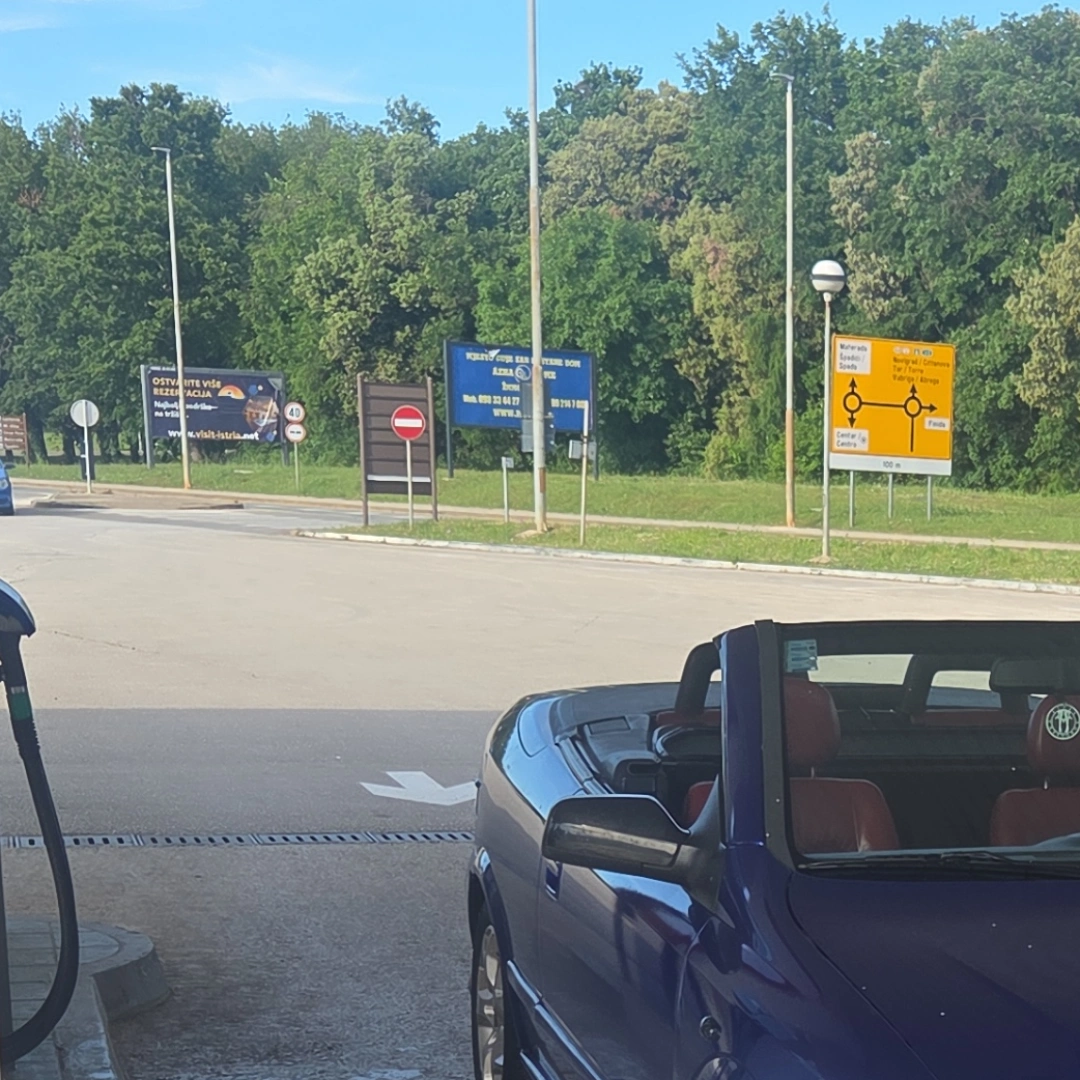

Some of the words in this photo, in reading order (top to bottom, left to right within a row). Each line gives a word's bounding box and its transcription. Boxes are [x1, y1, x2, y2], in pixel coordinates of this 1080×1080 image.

[202, 378, 221, 389] VIŠE
[153, 387, 212, 398] REZERACIJA
[289, 407, 300, 418] 40
